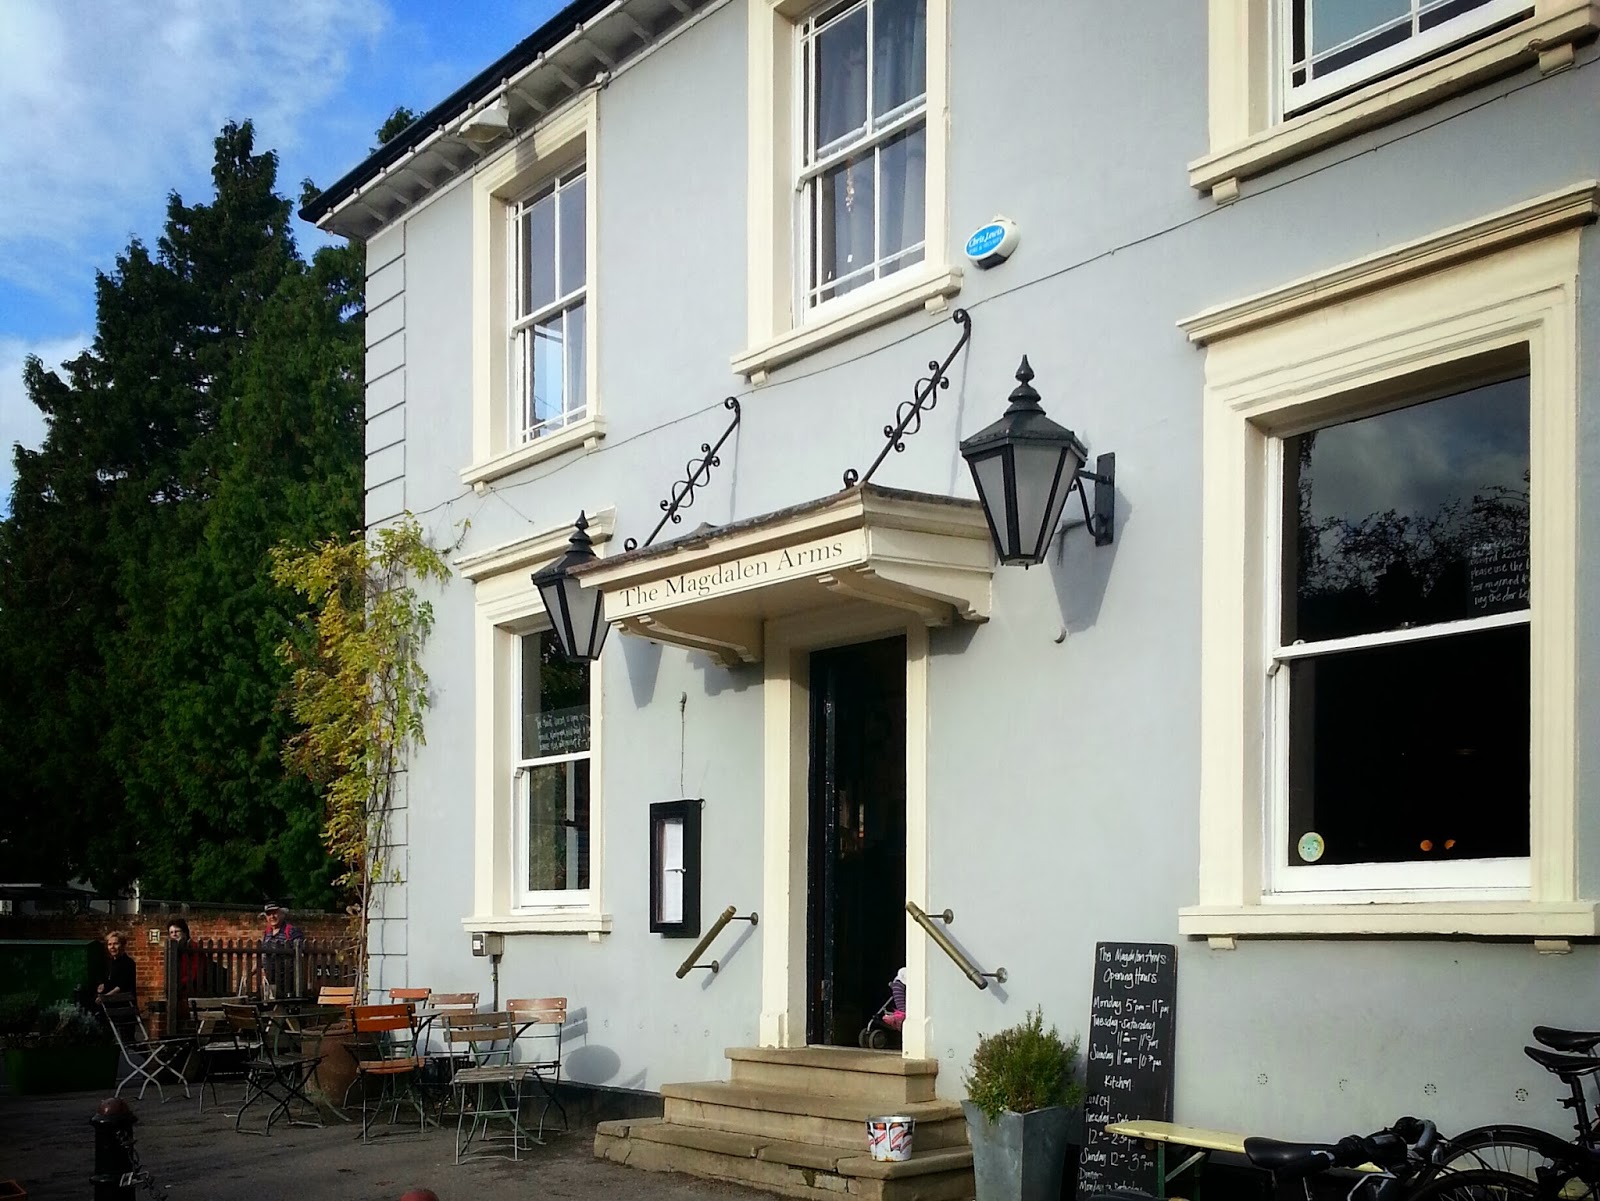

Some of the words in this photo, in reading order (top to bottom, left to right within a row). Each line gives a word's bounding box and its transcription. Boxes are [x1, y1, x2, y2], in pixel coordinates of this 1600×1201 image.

[619, 586, 658, 607] The
[665, 560, 769, 596] Magdalen
[776, 542, 843, 571] Arms
[1103, 967, 1134, 989] Opening
[1134, 966, 1158, 985] Hours
[1093, 994, 1122, 1015] Monday
[1090, 1043, 1114, 1067] Sunday
[1080, 1147, 1107, 1167] Sunday
